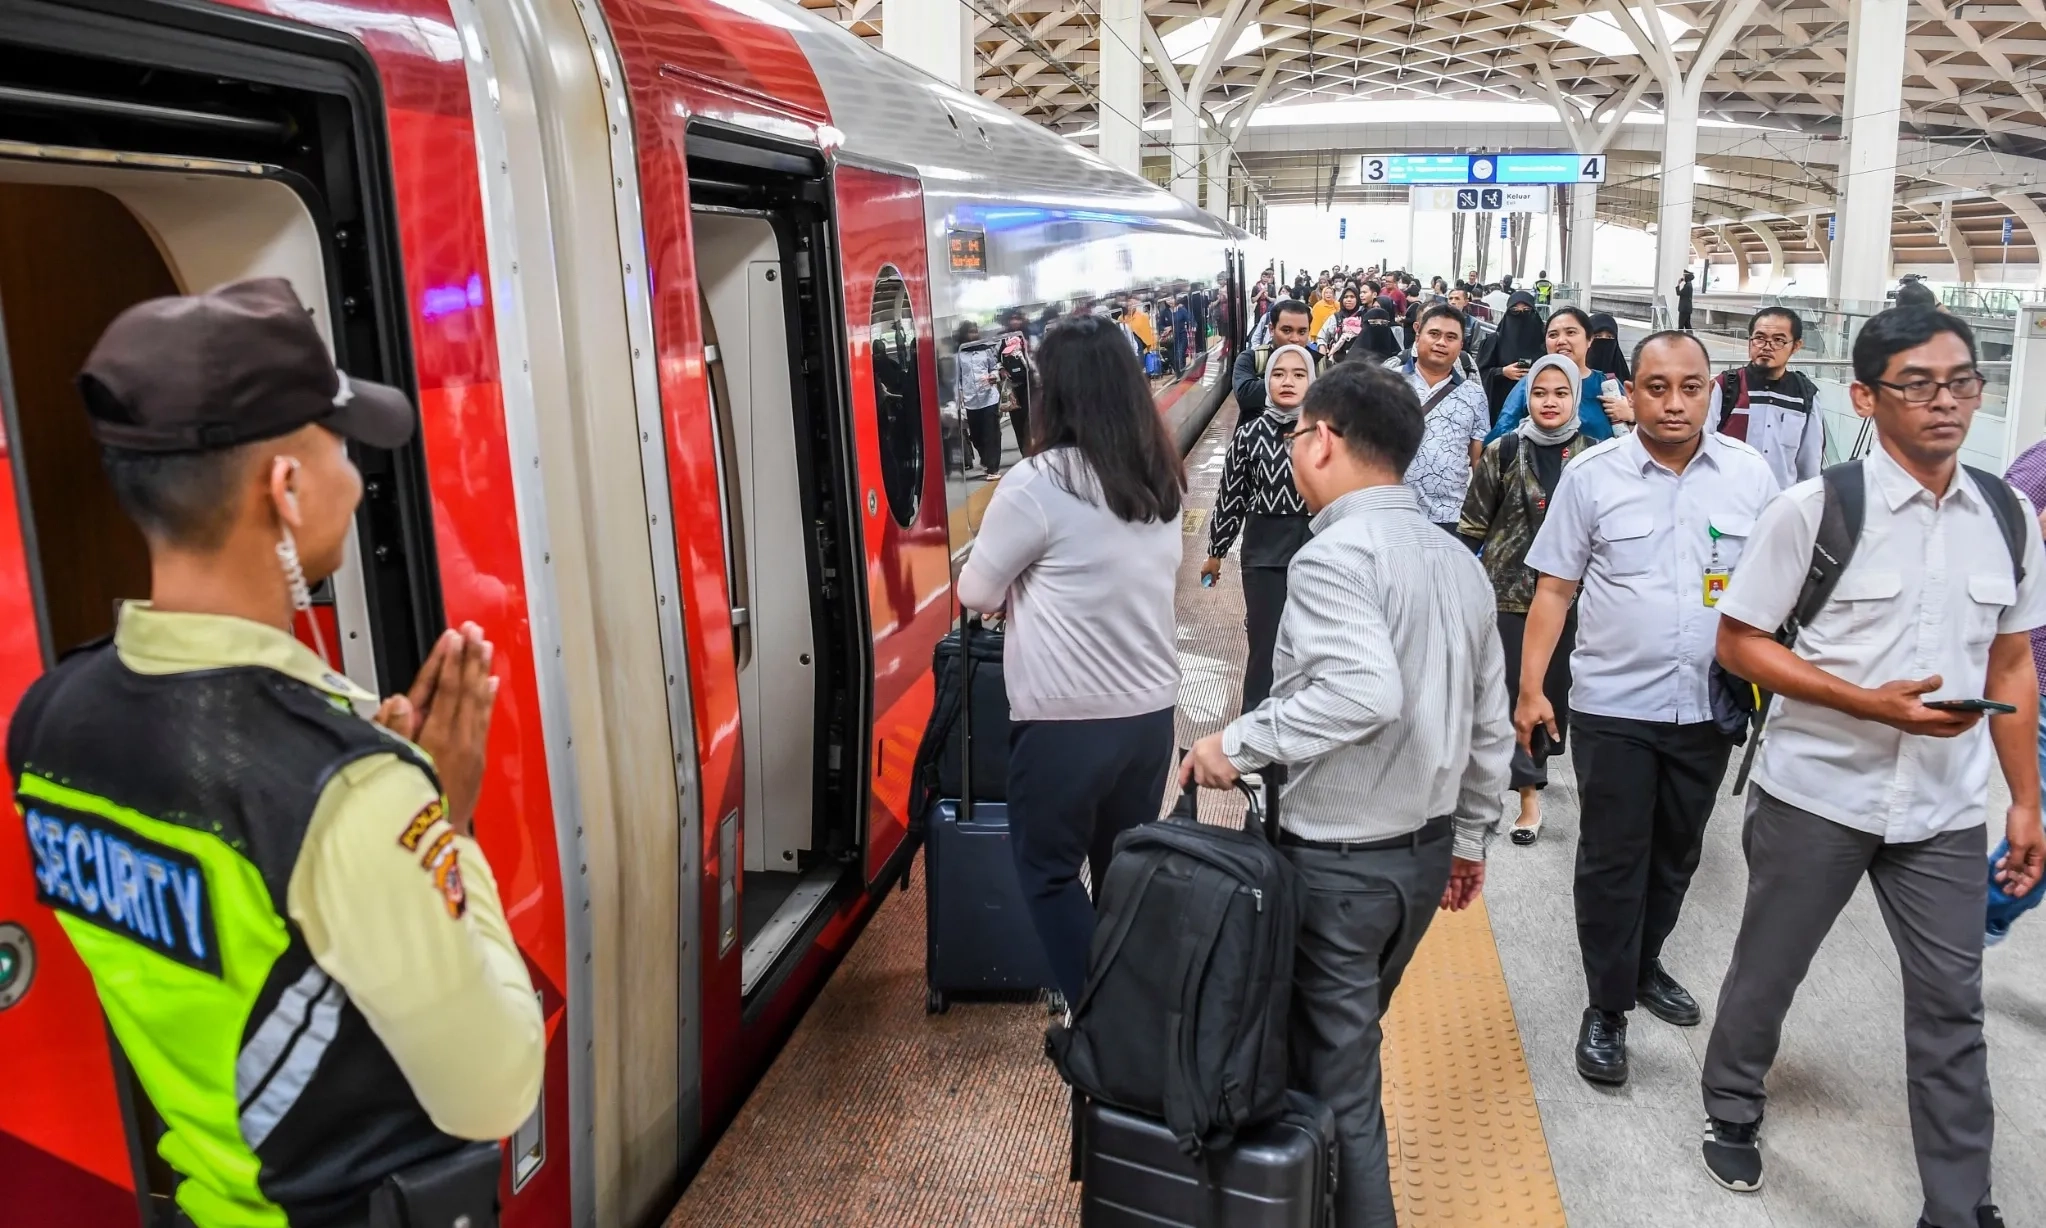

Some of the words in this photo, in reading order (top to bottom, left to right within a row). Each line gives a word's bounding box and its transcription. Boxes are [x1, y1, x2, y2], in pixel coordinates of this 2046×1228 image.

[1368, 159, 1384, 180] 3
[1582, 158, 1600, 179] 4
[402, 803, 442, 849] POLD
[27, 808, 206, 959] SECURITY
